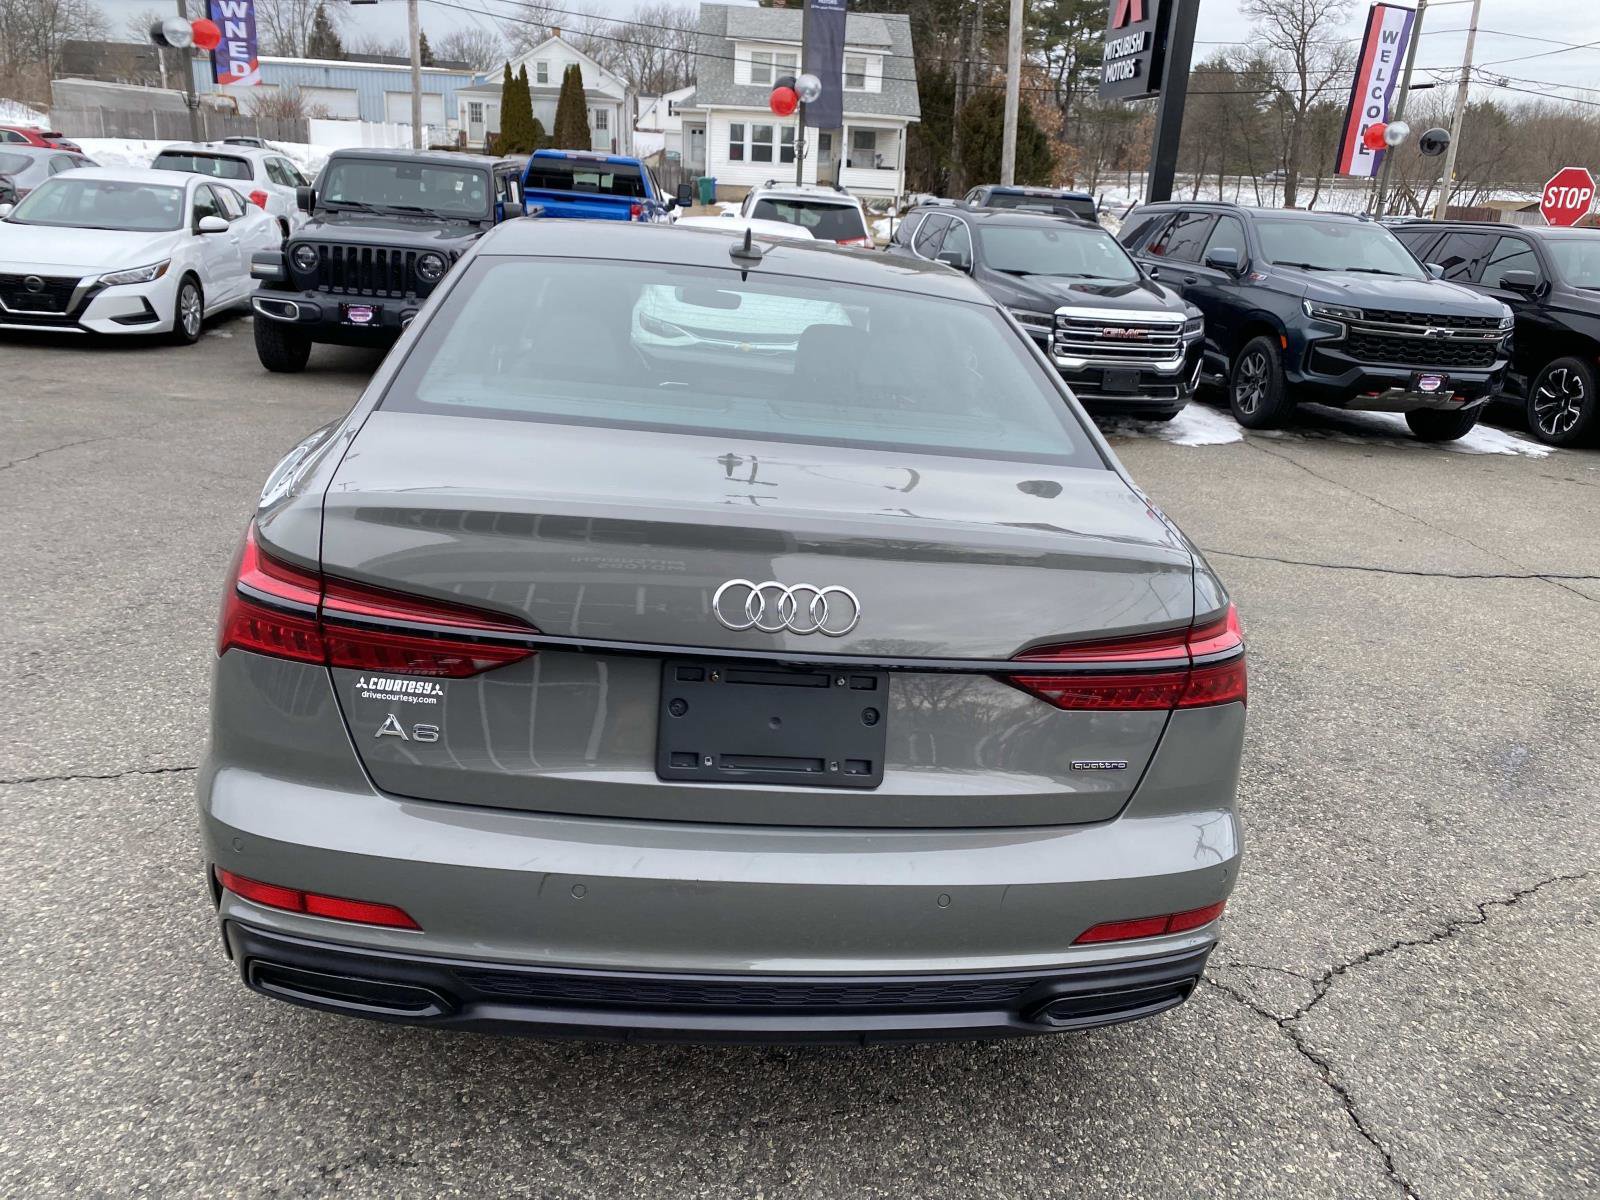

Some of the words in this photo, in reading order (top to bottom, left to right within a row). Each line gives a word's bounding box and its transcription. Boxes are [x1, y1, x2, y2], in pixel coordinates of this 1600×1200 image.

[1103, 31, 1145, 61] MITSUBISHI
[1105, 58, 1136, 83] MOTORS
[1544, 186, 1591, 209] STOP
[1103, 327, 1149, 339] GMC
[361, 690, 437, 704] drivecourtesy.com
[374, 713, 440, 743] A6
[1074, 762, 1126, 770] quattro
